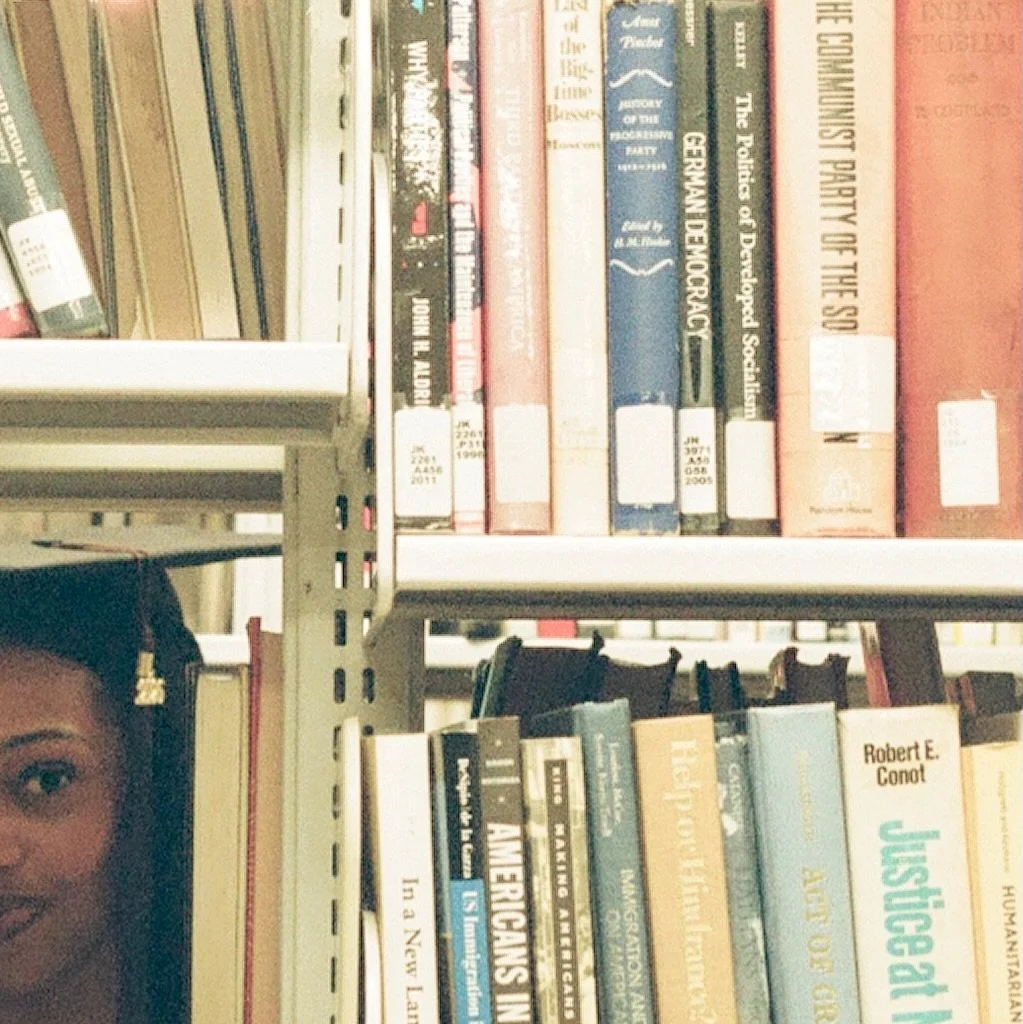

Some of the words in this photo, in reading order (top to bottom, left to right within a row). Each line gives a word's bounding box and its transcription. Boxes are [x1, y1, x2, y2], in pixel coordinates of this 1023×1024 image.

[736, 93, 753, 129] The
[816, 32, 856, 153] COMMUNIST
[0, 116, 27, 168] SEXUAL
[683, 132, 707, 214] GERMAN
[737, 134, 754, 201] Politics
[819, 160, 858, 226] PARTY
[739, 206, 756, 230] of
[821, 232, 859, 256] OF
[684, 218, 711, 340] DEMOCRACY
[736, 232, 760, 329] Developed
[821, 262, 859, 298] THE
[412, 298, 431, 337] JOHN
[821, 305, 860, 335] SO
[413, 341, 431, 358] H.
[413, 361, 431, 406] ALDRI
[742, 333, 761, 419] Socialism
[863, 741, 921, 764] Robert
[925, 739, 940, 761] E.
[552, 766, 563, 806] KING
[876, 764, 927, 786] Conot
[554, 823, 569, 899] MAKING
[402, 877, 420, 900] In
[461, 890, 478, 911] US
[487, 823, 531, 986] AMERICANS
[801, 866, 831, 923] ACT
[878, 818, 946, 957] Justice
[402, 910, 415, 921] a
[404, 927, 423, 975] New
[462, 916, 483, 1017] Immigration
[558, 908, 575, 1020] AMERICANS
[807, 932, 835, 975] OF
[1002, 885, 1023, 1023] HUMANITARIAN
[887, 961, 950, 999] at
[496, 993, 532, 1024] IN
